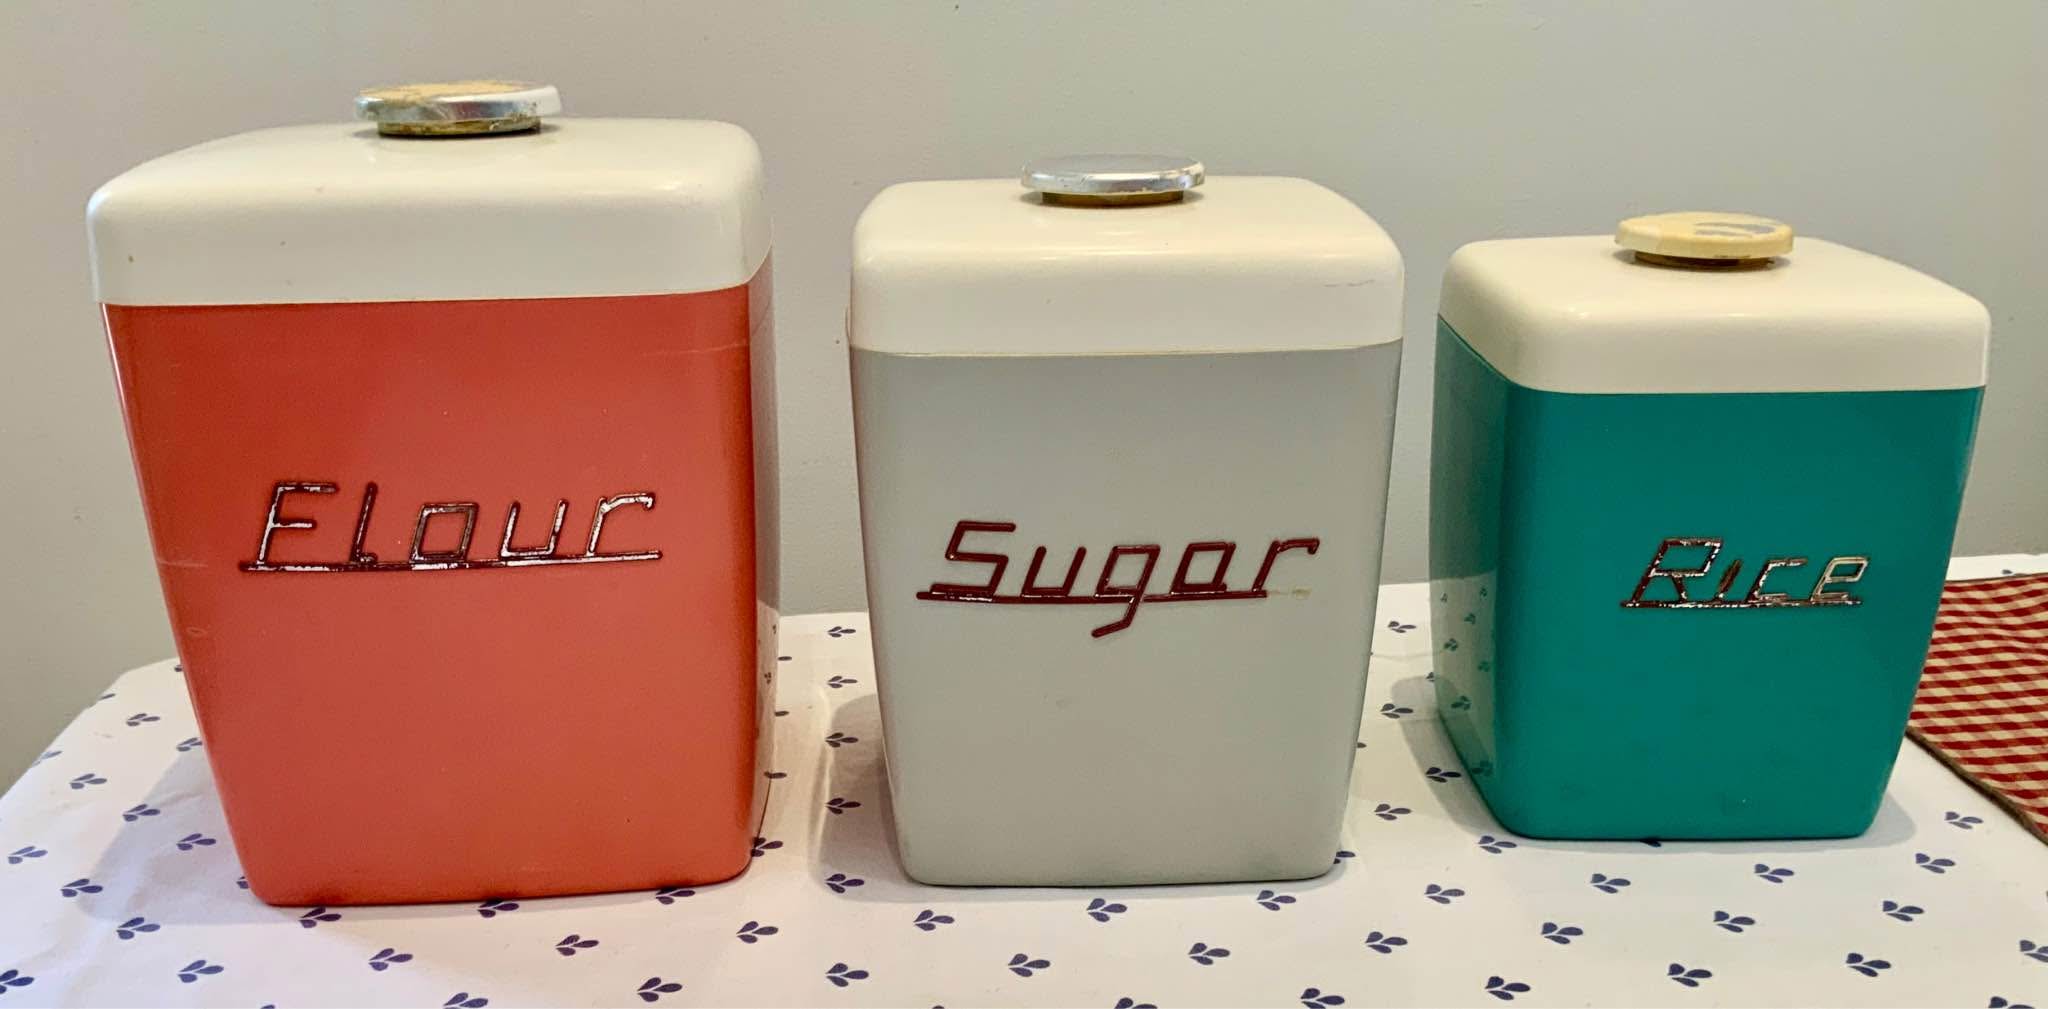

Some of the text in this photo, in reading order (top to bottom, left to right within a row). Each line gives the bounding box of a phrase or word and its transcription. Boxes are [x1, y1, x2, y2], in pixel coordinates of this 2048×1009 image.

[248, 481, 657, 570] Flour
[925, 520, 1320, 638] Sugar
[1625, 537, 1870, 606] Rice
